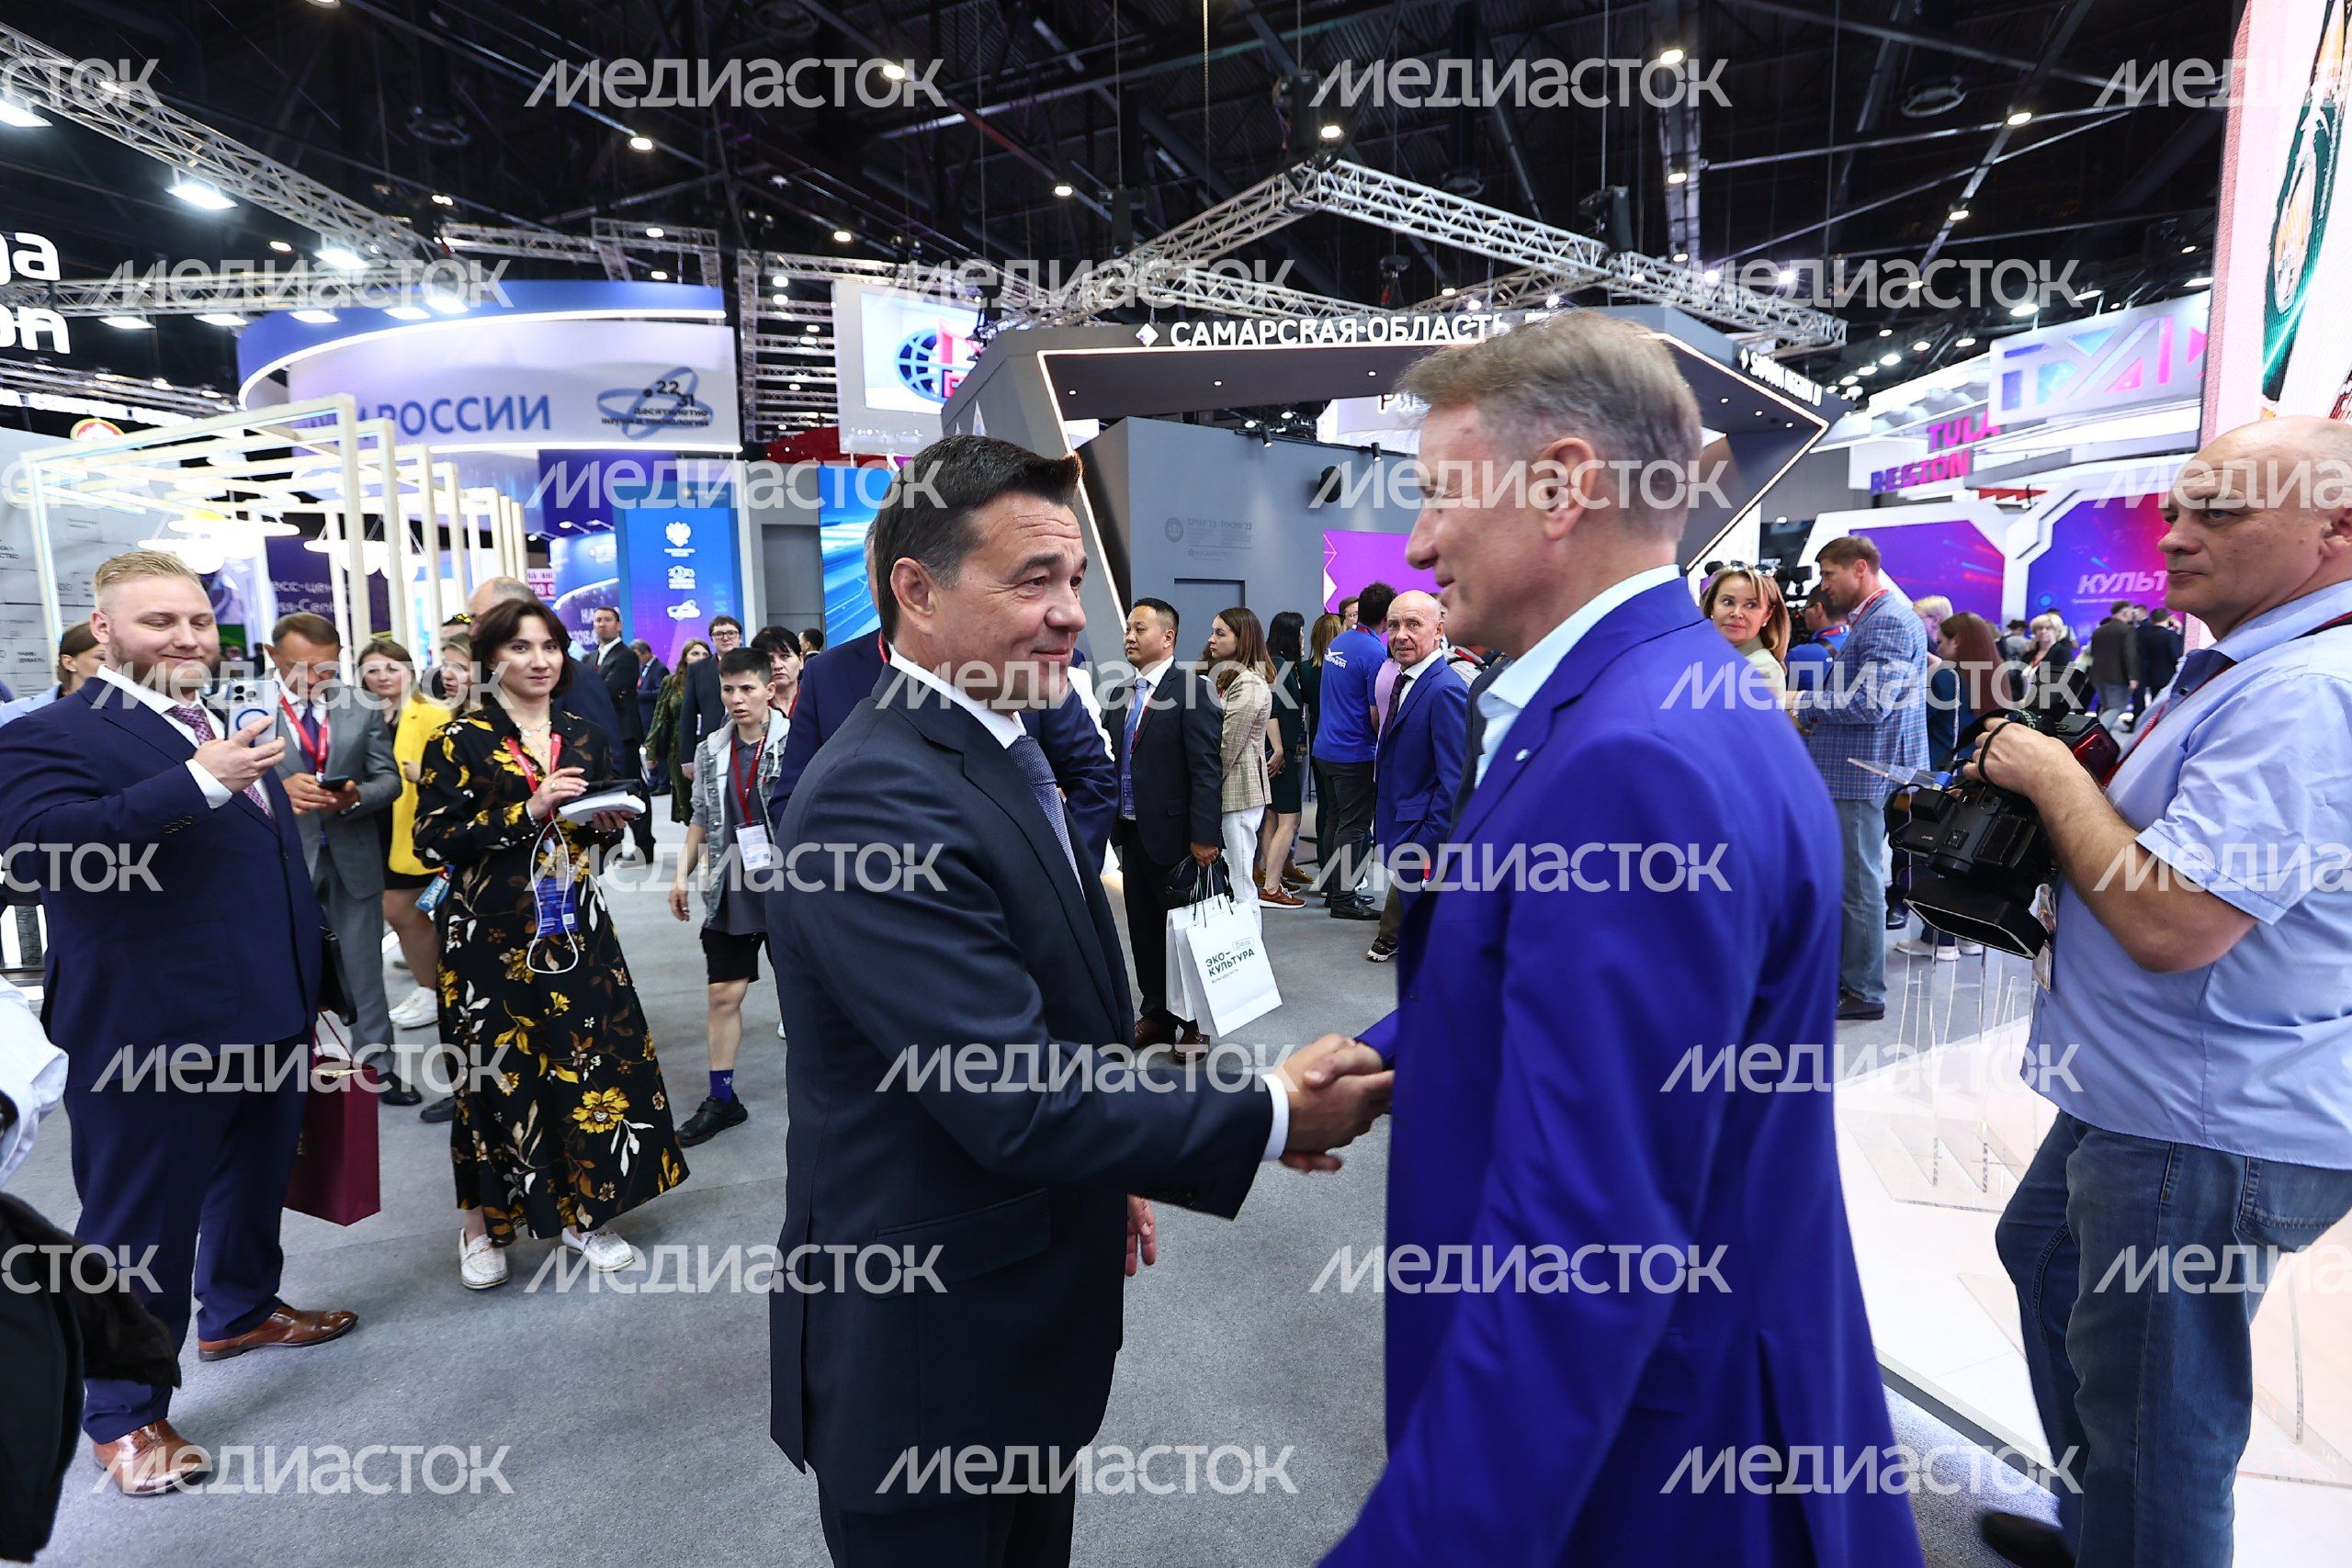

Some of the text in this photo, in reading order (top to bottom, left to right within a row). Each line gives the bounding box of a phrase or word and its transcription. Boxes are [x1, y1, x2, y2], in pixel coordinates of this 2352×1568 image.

[1170, 319, 1358, 346] САМАРСКАЯ
[1368, 314, 1511, 343] ОБЛАСТЬ
[1928, 412, 2001, 452] TULA
[1870, 449, 1971, 494] REGION
[1208, 948, 1255, 976] КУЛЬТУРА
